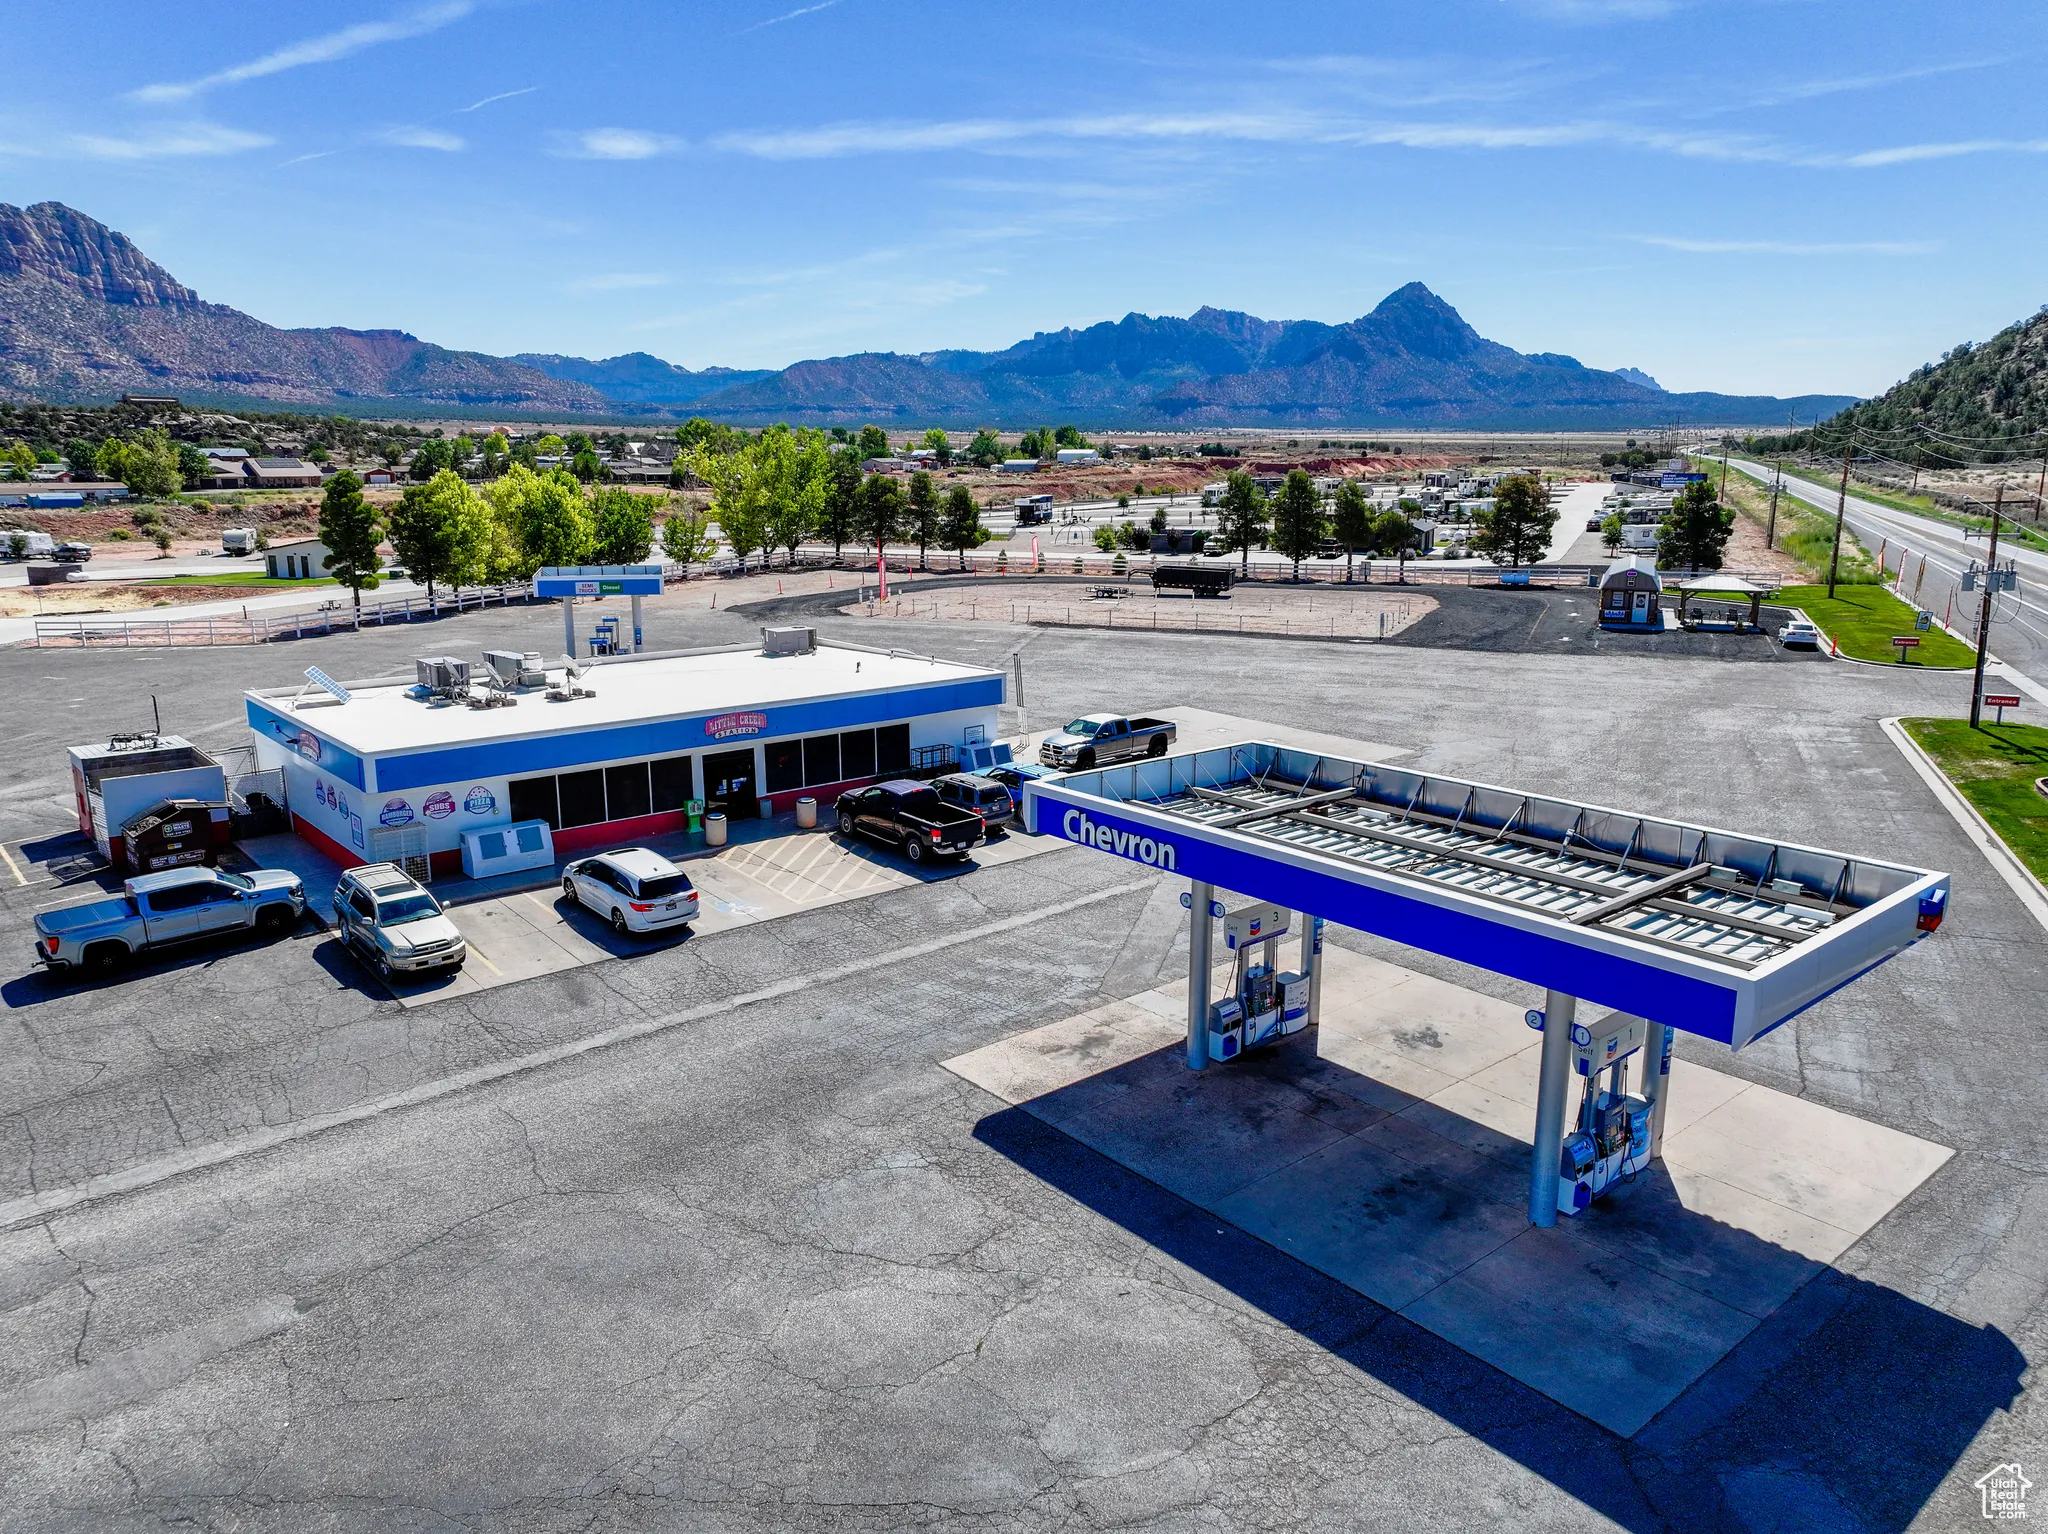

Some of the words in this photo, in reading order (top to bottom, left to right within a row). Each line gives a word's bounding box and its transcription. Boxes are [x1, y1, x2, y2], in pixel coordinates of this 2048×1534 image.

[709, 716, 737, 732] LITTLE
[717, 727, 757, 738] STATION
[428, 802, 450, 812] SUBS
[469, 796, 491, 808] PIZZA
[381, 809, 413, 820] HAMBURGER
[1063, 808, 1176, 871] Chevron
[1217, 906, 1222, 914] 3
[1272, 911, 1279, 922] 3
[1227, 923, 1238, 933] Self
[1530, 1014, 1537, 1025] 2
[1628, 1027, 1633, 1040] 1
[1577, 1045, 1594, 1056] Self
